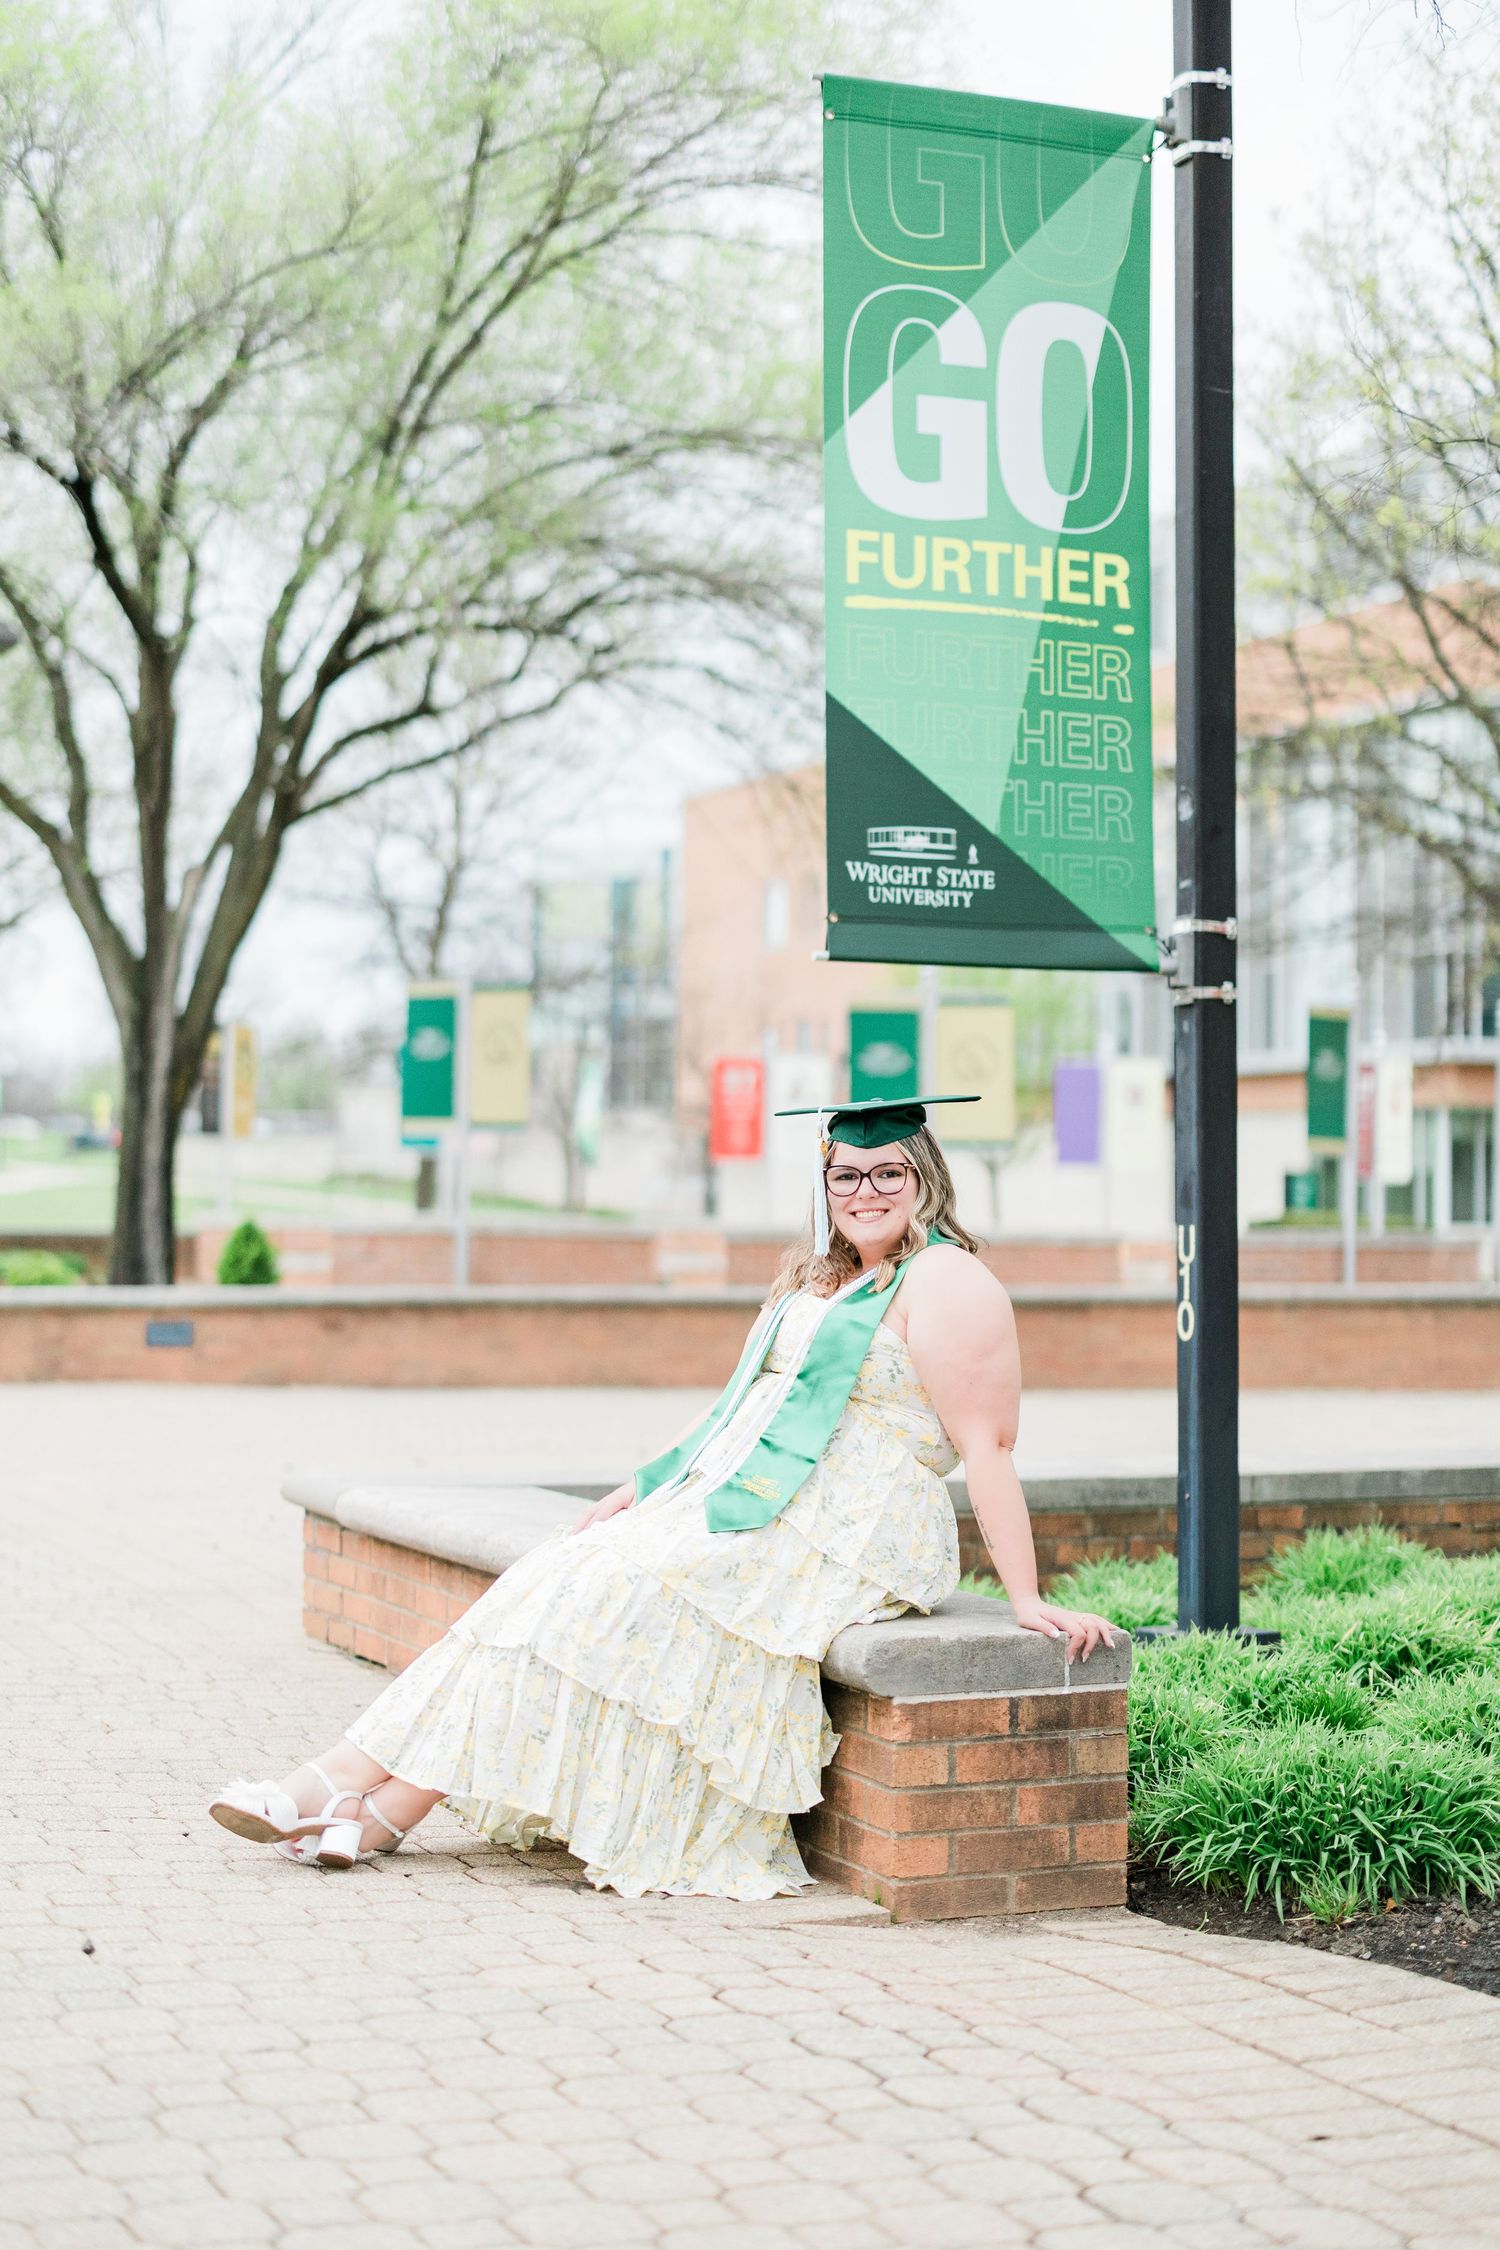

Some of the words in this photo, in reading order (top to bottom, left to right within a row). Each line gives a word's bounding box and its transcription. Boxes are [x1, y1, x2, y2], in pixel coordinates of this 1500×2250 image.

[844, 283, 1133, 534] GO
[845, 529, 1131, 609] FURTHER
[846, 623, 1133, 703] FURTHER
[845, 860, 932, 885] WRIGHT
[937, 867, 995, 889] STATE
[868, 886, 973, 908] UNIVERSITY
